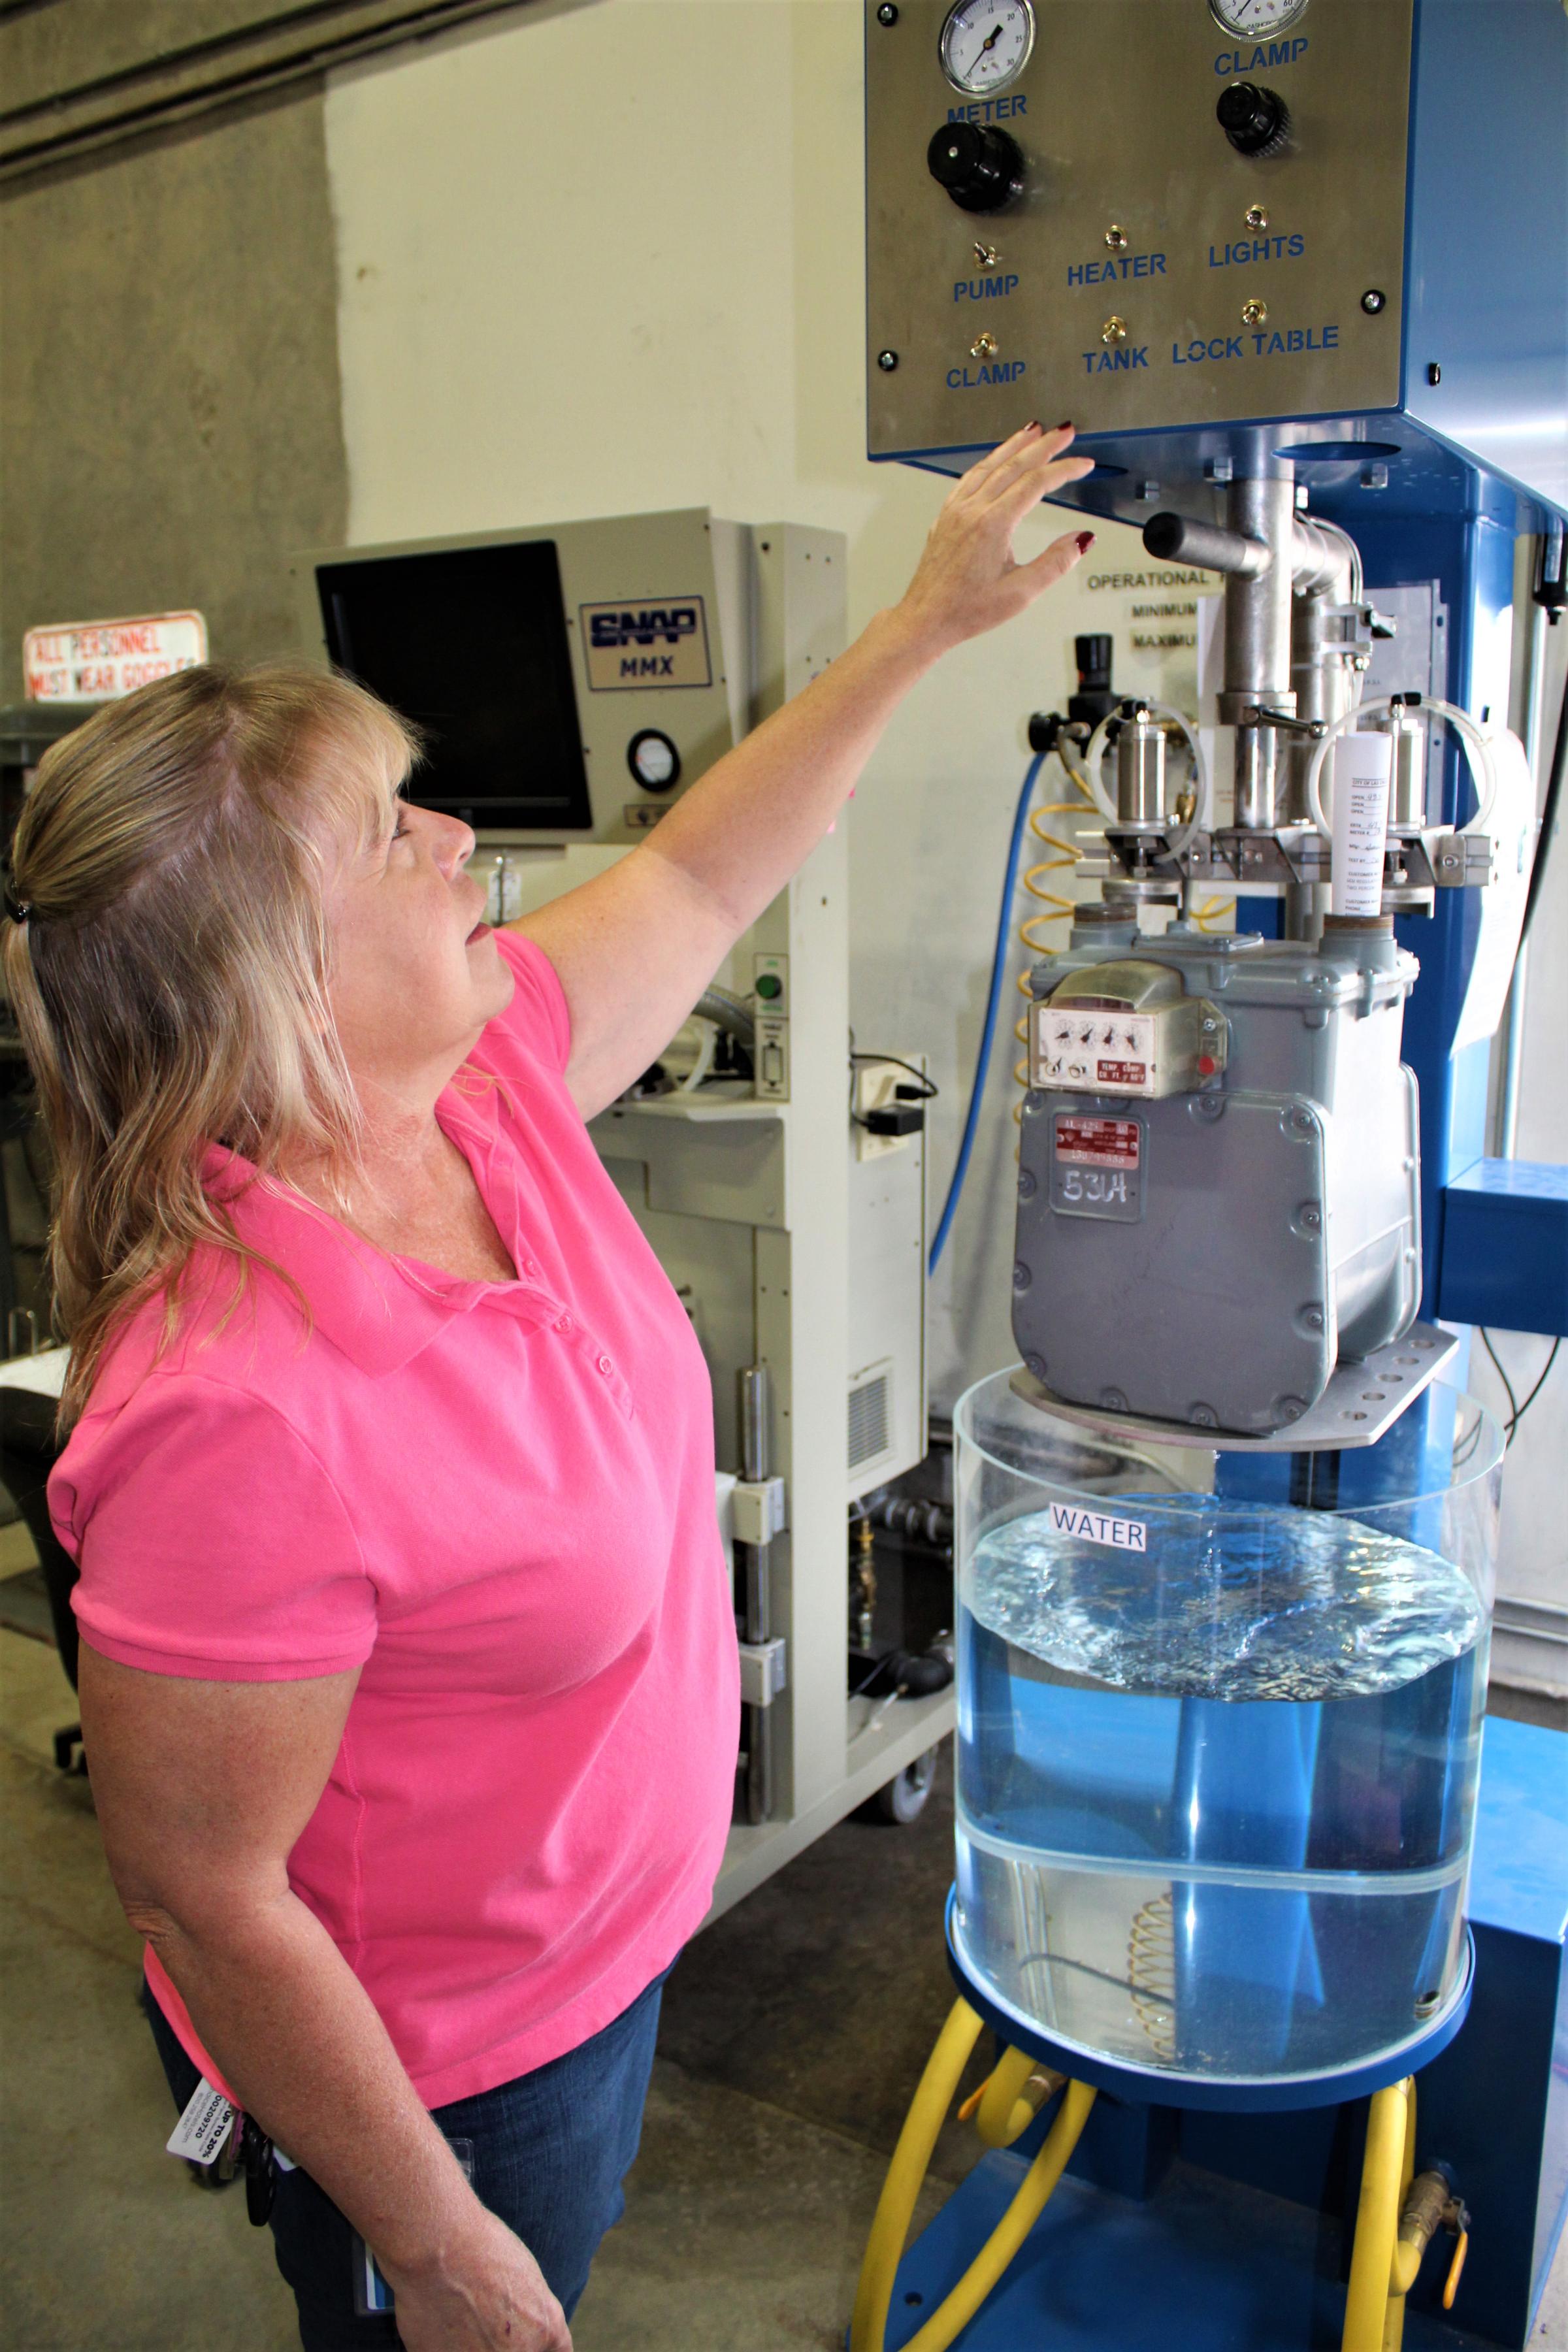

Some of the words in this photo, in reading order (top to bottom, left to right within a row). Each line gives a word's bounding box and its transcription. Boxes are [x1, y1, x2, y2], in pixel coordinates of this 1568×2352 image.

[1215, 38, 1309, 75] CLAMP
[947, 95, 1028, 126] METER
[1209, 234, 1305, 268] LIGHTS
[1068, 253, 1167, 286] HEATER
[954, 274, 1019, 302] PUMP
[1082, 346, 1149, 374] TANK
[1172, 335, 1243, 364] LOCK
[1252, 326, 1339, 356] TABLE
[946, 361, 1026, 389] CLAMP
[1087, 570, 1210, 589] OPERATIONAL
[591, 608, 696, 647] SNAP
[1133, 634, 1196, 647] MAXIMU
[35, 634, 63, 662] ALL
[71, 625, 161, 661] PERSONNEL
[29, 668, 68, 696] MUST
[74, 665, 115, 693] WEAR
[620, 655, 674, 677] MMX
[1053, 1506, 1143, 1547] WATER
[195, 2095, 222, 2138] 00209720
[214, 2125, 225, 2136] TO
[222, 2110, 231, 2123] UP
[203, 2138, 217, 2158] 20%
